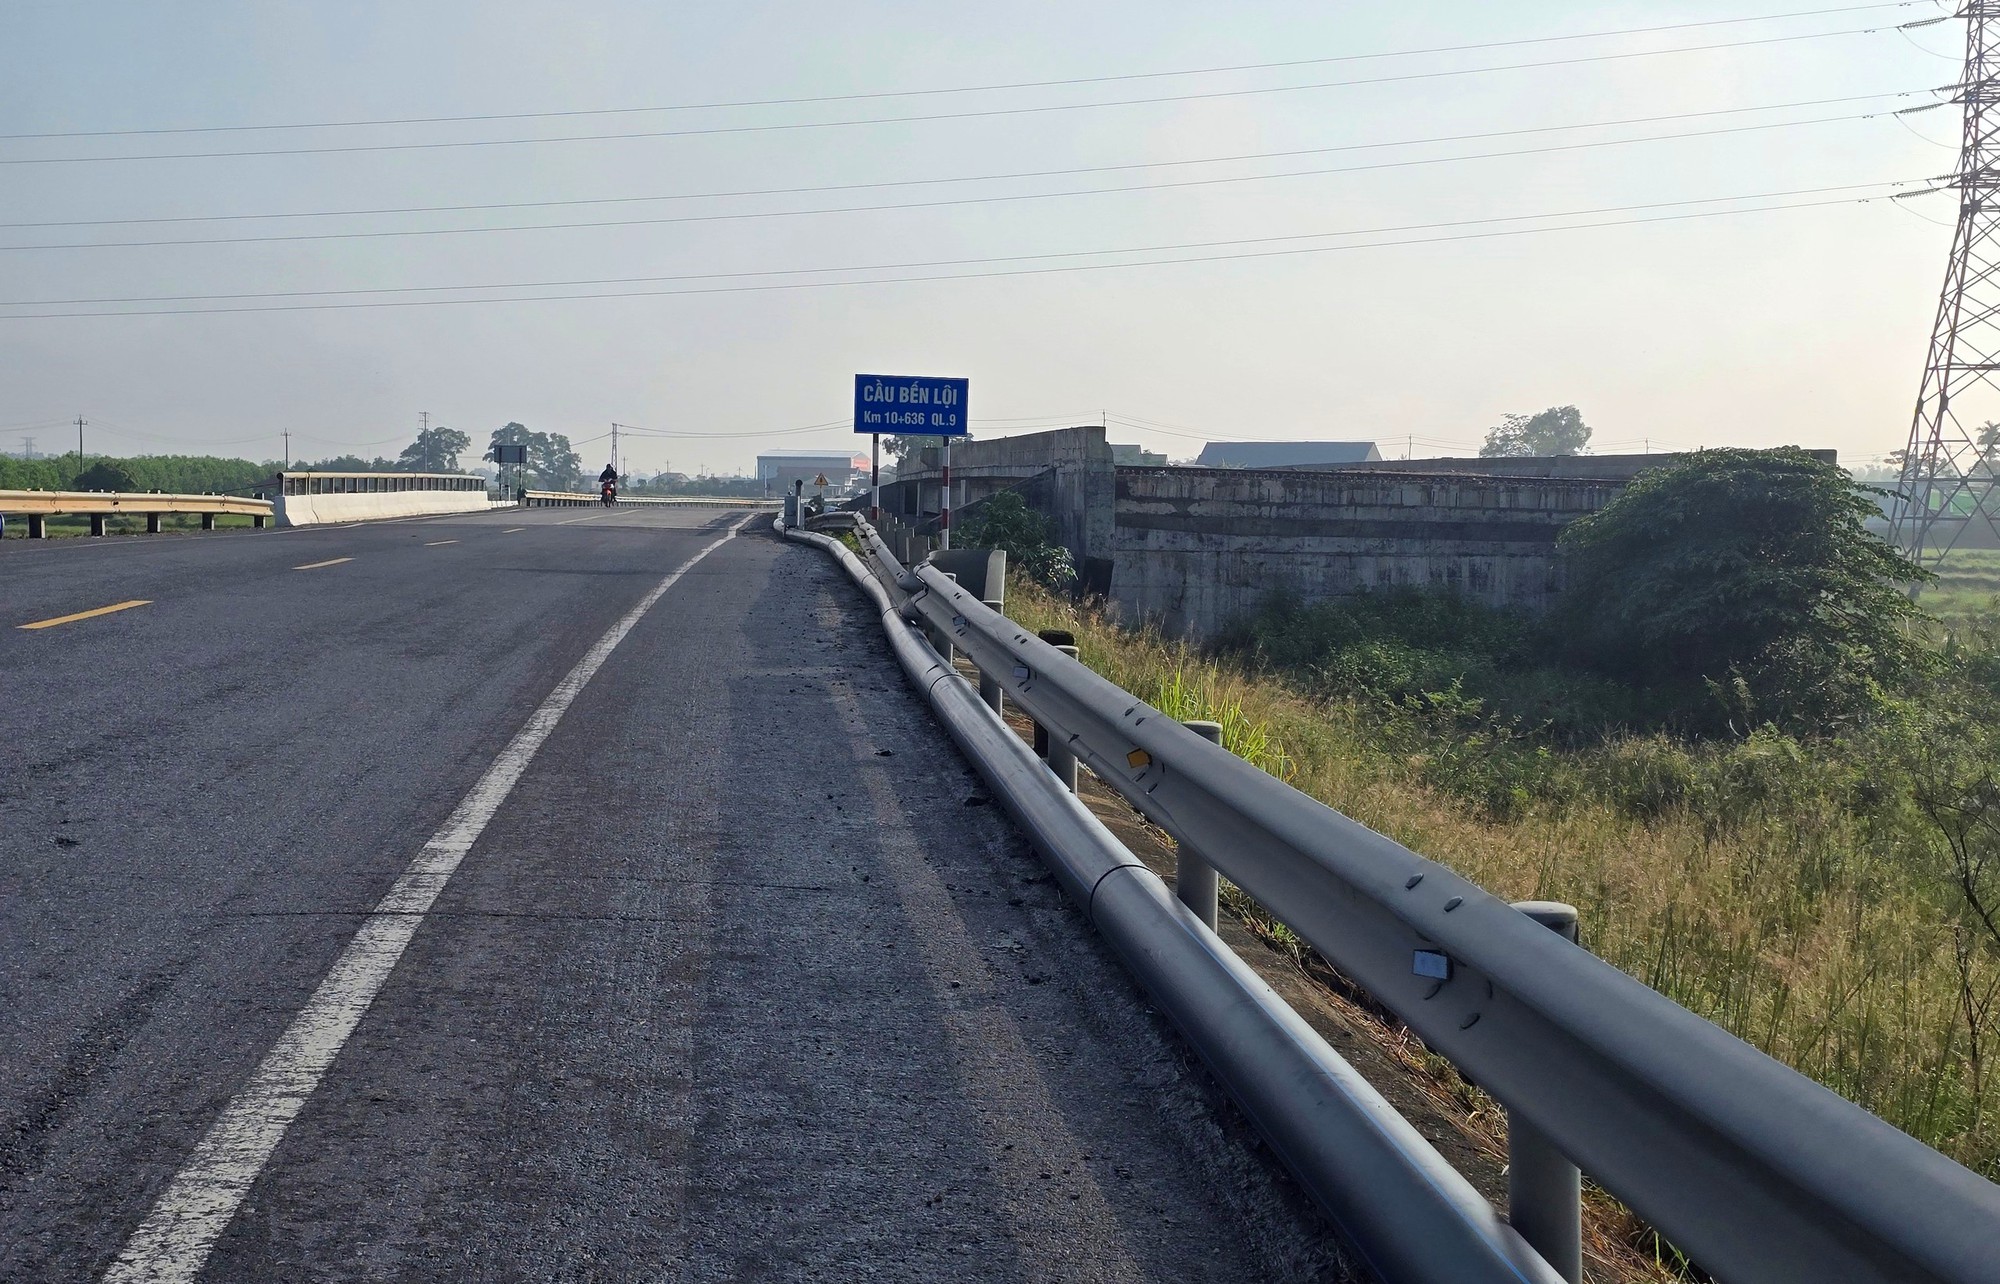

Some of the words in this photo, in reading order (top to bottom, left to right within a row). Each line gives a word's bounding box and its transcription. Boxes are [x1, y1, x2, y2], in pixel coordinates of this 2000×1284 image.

[863, 379, 895, 403] CẦU
[899, 380, 929, 404] BẾN
[933, 384, 958, 409] LỘI
[863, 410, 881, 423] Km
[884, 411, 925, 425] 10+636
[931, 413, 956, 427] QL.9
